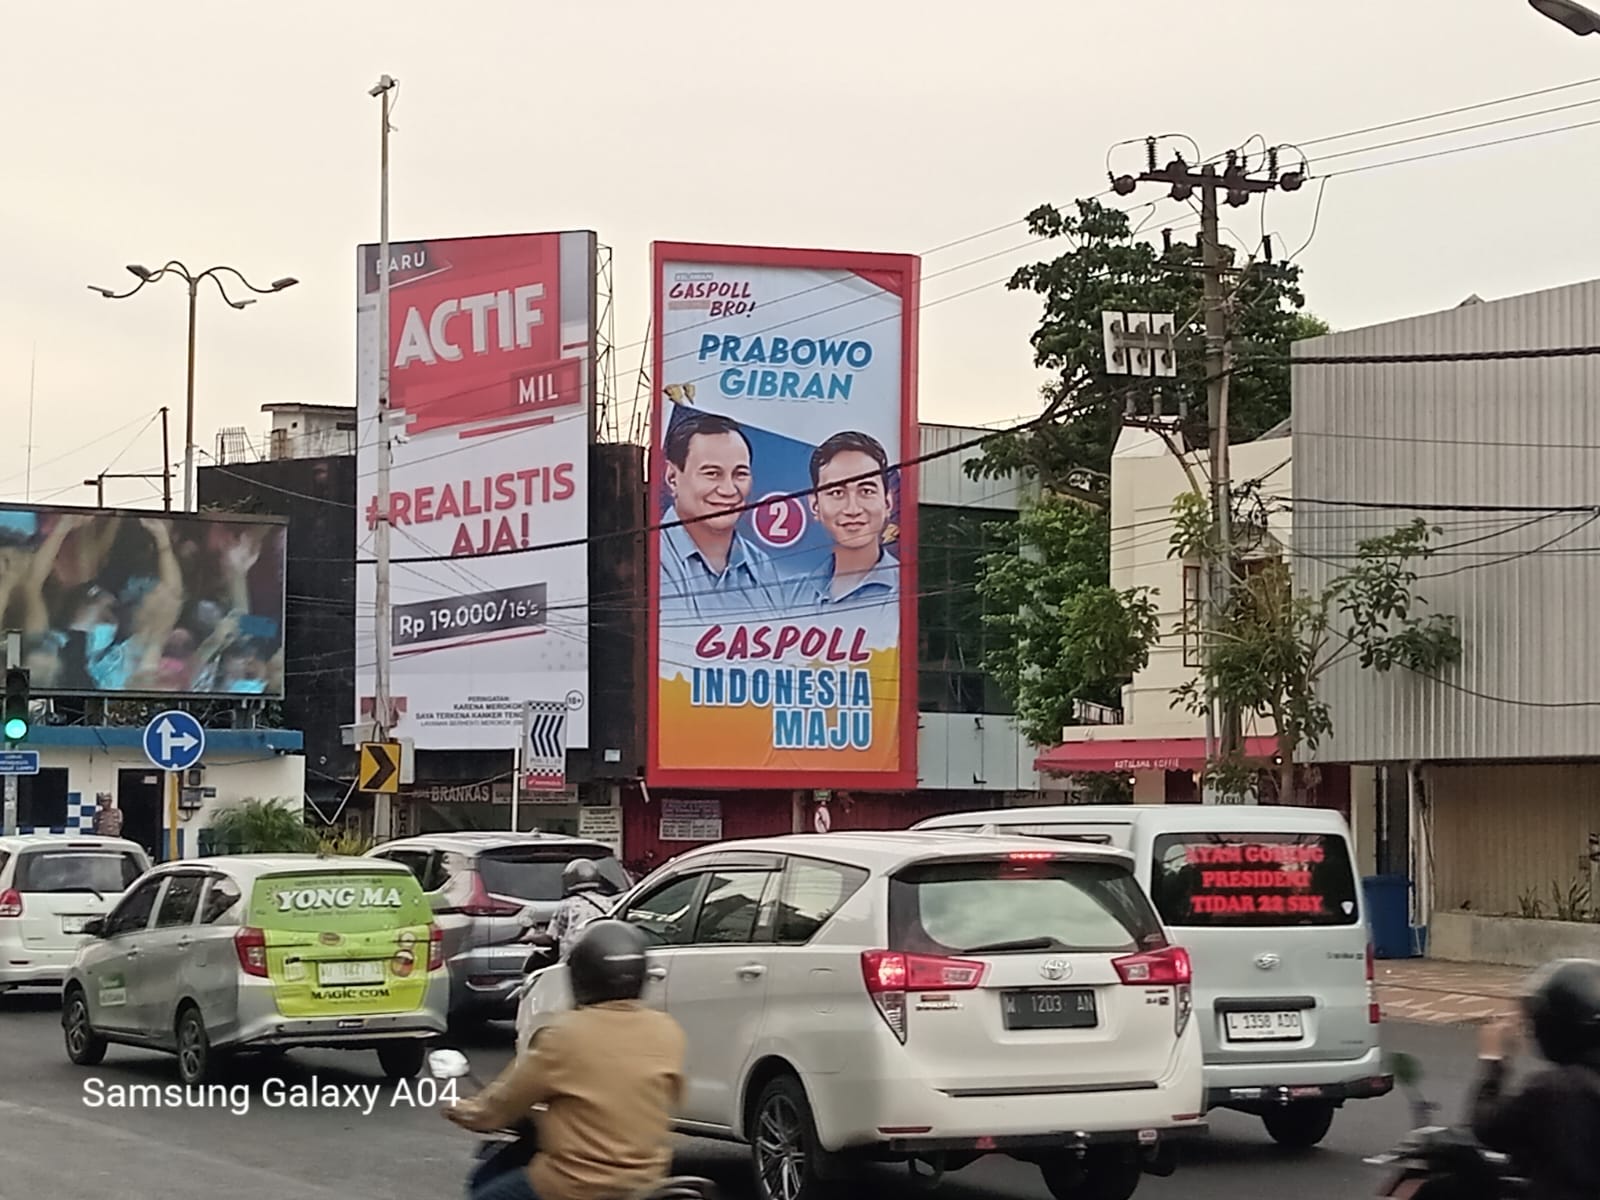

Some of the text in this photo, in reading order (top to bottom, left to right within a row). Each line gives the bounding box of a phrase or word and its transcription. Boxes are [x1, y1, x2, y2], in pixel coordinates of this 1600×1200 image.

[669, 282, 752, 299] GASPOLL
[709, 301, 756, 318] BRO!
[394, 282, 546, 369] ACTIF
[699, 335, 873, 367] PRABOWO
[519, 374, 559, 404] MIL
[720, 368, 853, 400] GIBRAN
[769, 502, 789, 537] 2
[451, 513, 529, 555] AJA!
[400, 616, 425, 639] Rp
[695, 625, 870, 662] GASPOLL
[692, 667, 870, 707] INDONESIA
[773, 709, 870, 749] MAJU
[431, 786, 490, 802] BRANKAS
[1201, 871, 1311, 888] PRESIDENT
[277, 887, 402, 912] YONG MA
[1190, 895, 1255, 913] TIDAR
[311, 990, 356, 1000] MAGIC
[1031, 995, 1062, 1013] 1203
[1229, 1015, 1238, 1029] L
